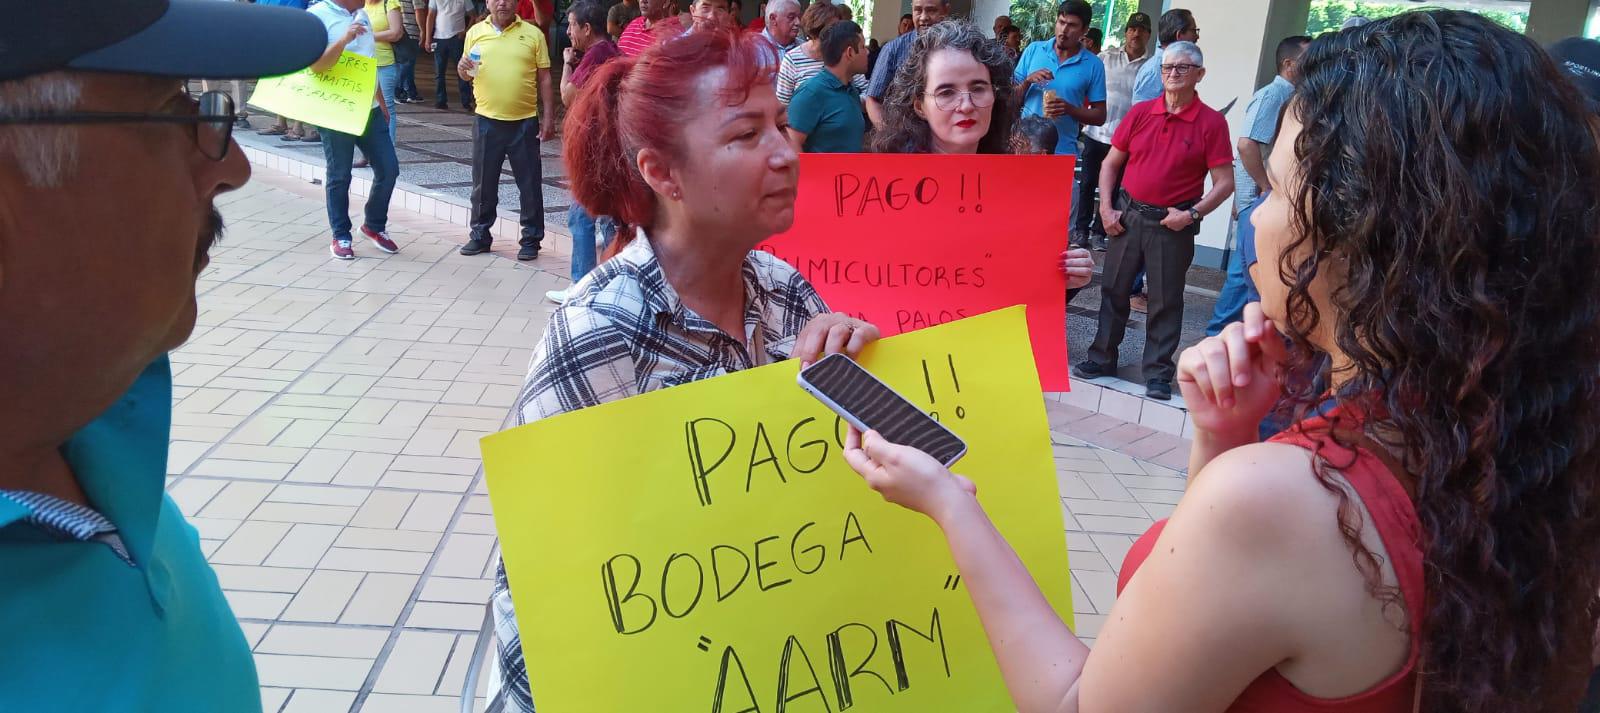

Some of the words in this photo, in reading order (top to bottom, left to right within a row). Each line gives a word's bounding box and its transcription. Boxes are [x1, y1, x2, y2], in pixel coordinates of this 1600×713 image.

[834, 172, 939, 217] PAGO
[957, 172, 983, 214] !!
[601, 511, 873, 636] BODEGA
